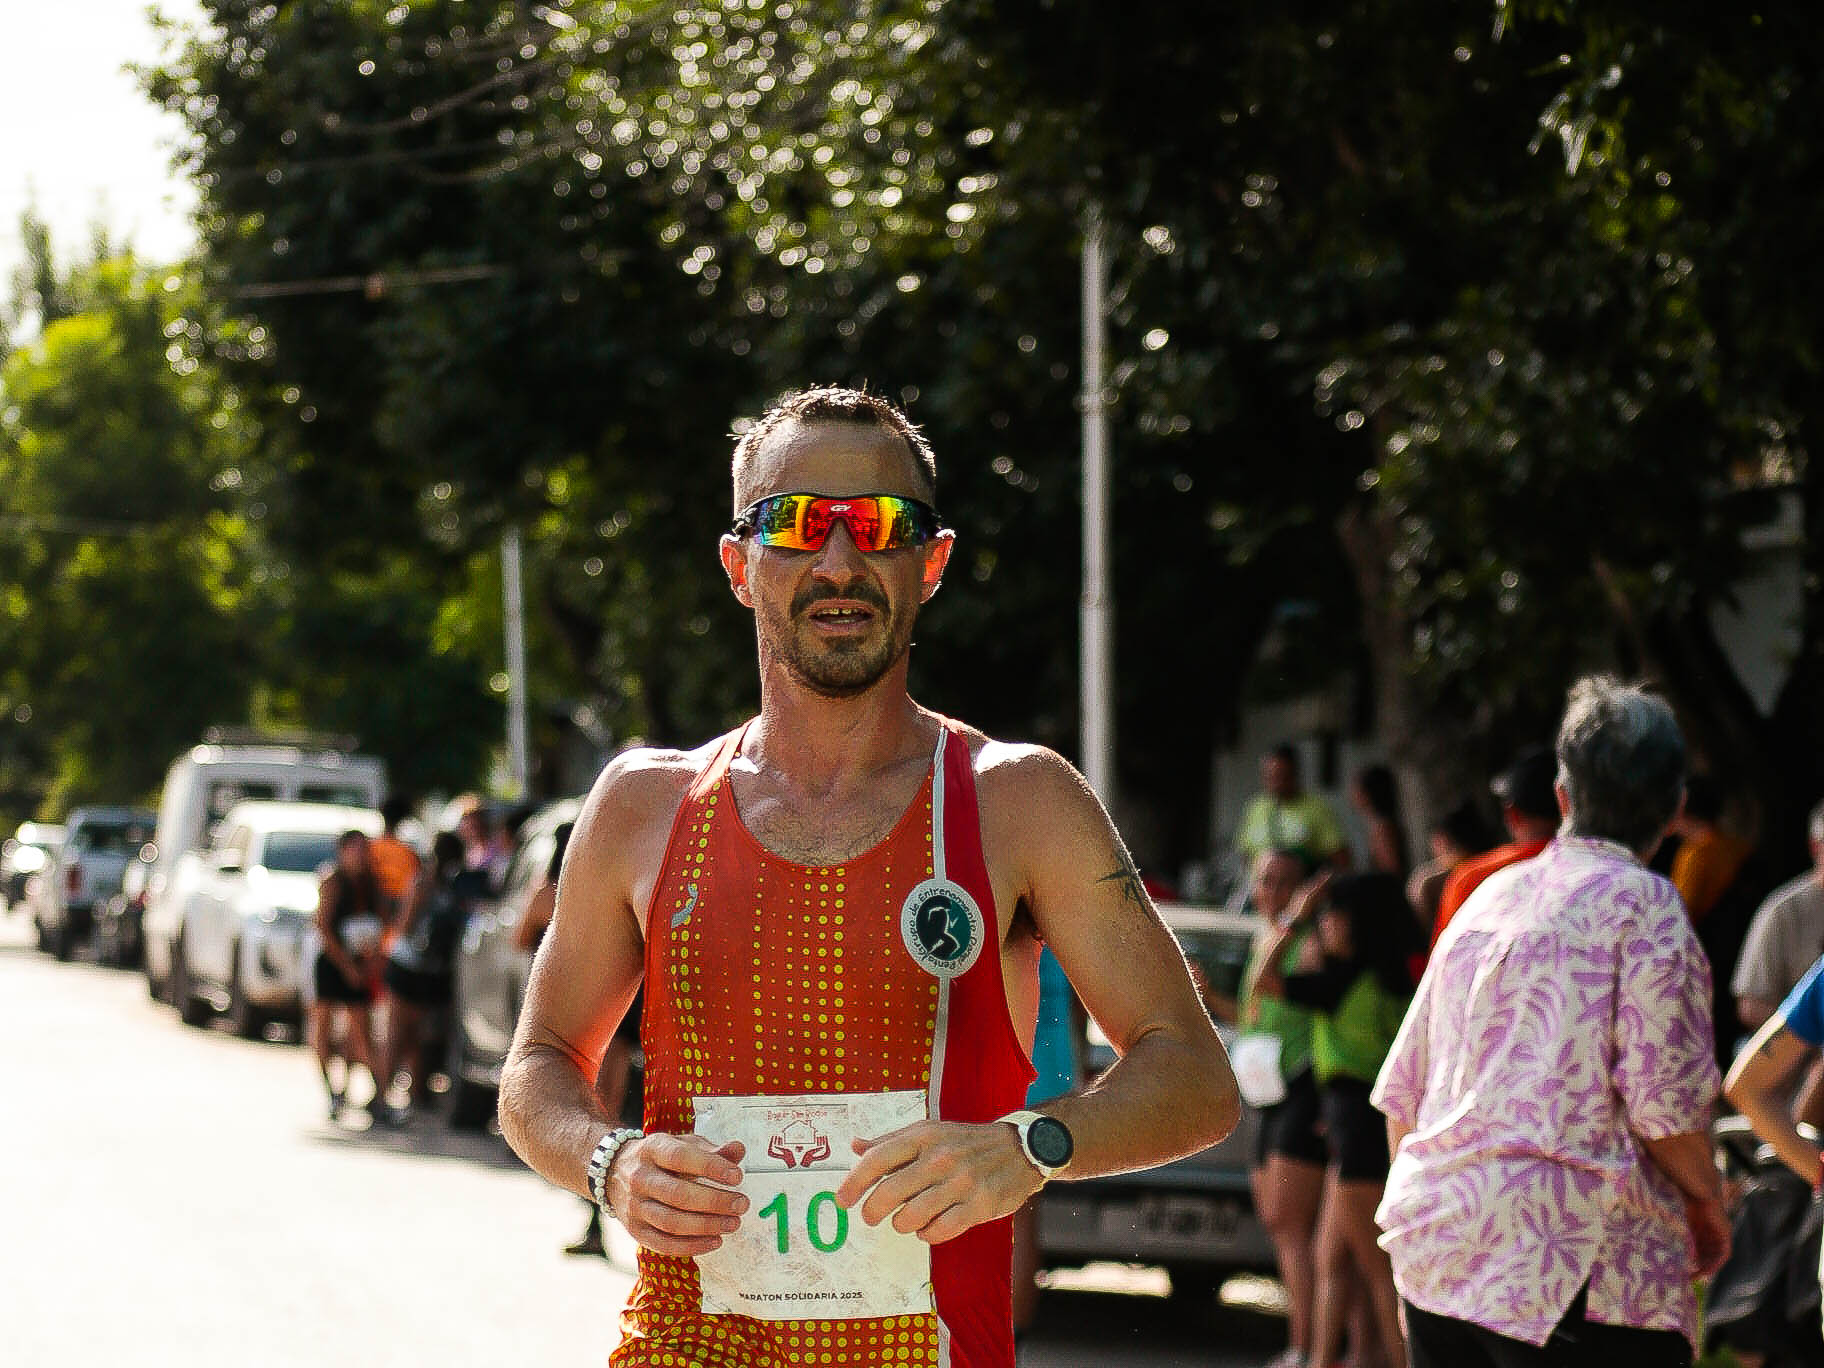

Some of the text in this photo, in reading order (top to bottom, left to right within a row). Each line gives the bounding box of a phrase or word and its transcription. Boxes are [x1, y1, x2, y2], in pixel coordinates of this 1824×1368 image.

[759, 1191, 849, 1253] 10
[784, 1292, 838, 1300] SOLIDARIA
[840, 1291, 863, 1299] 2025
